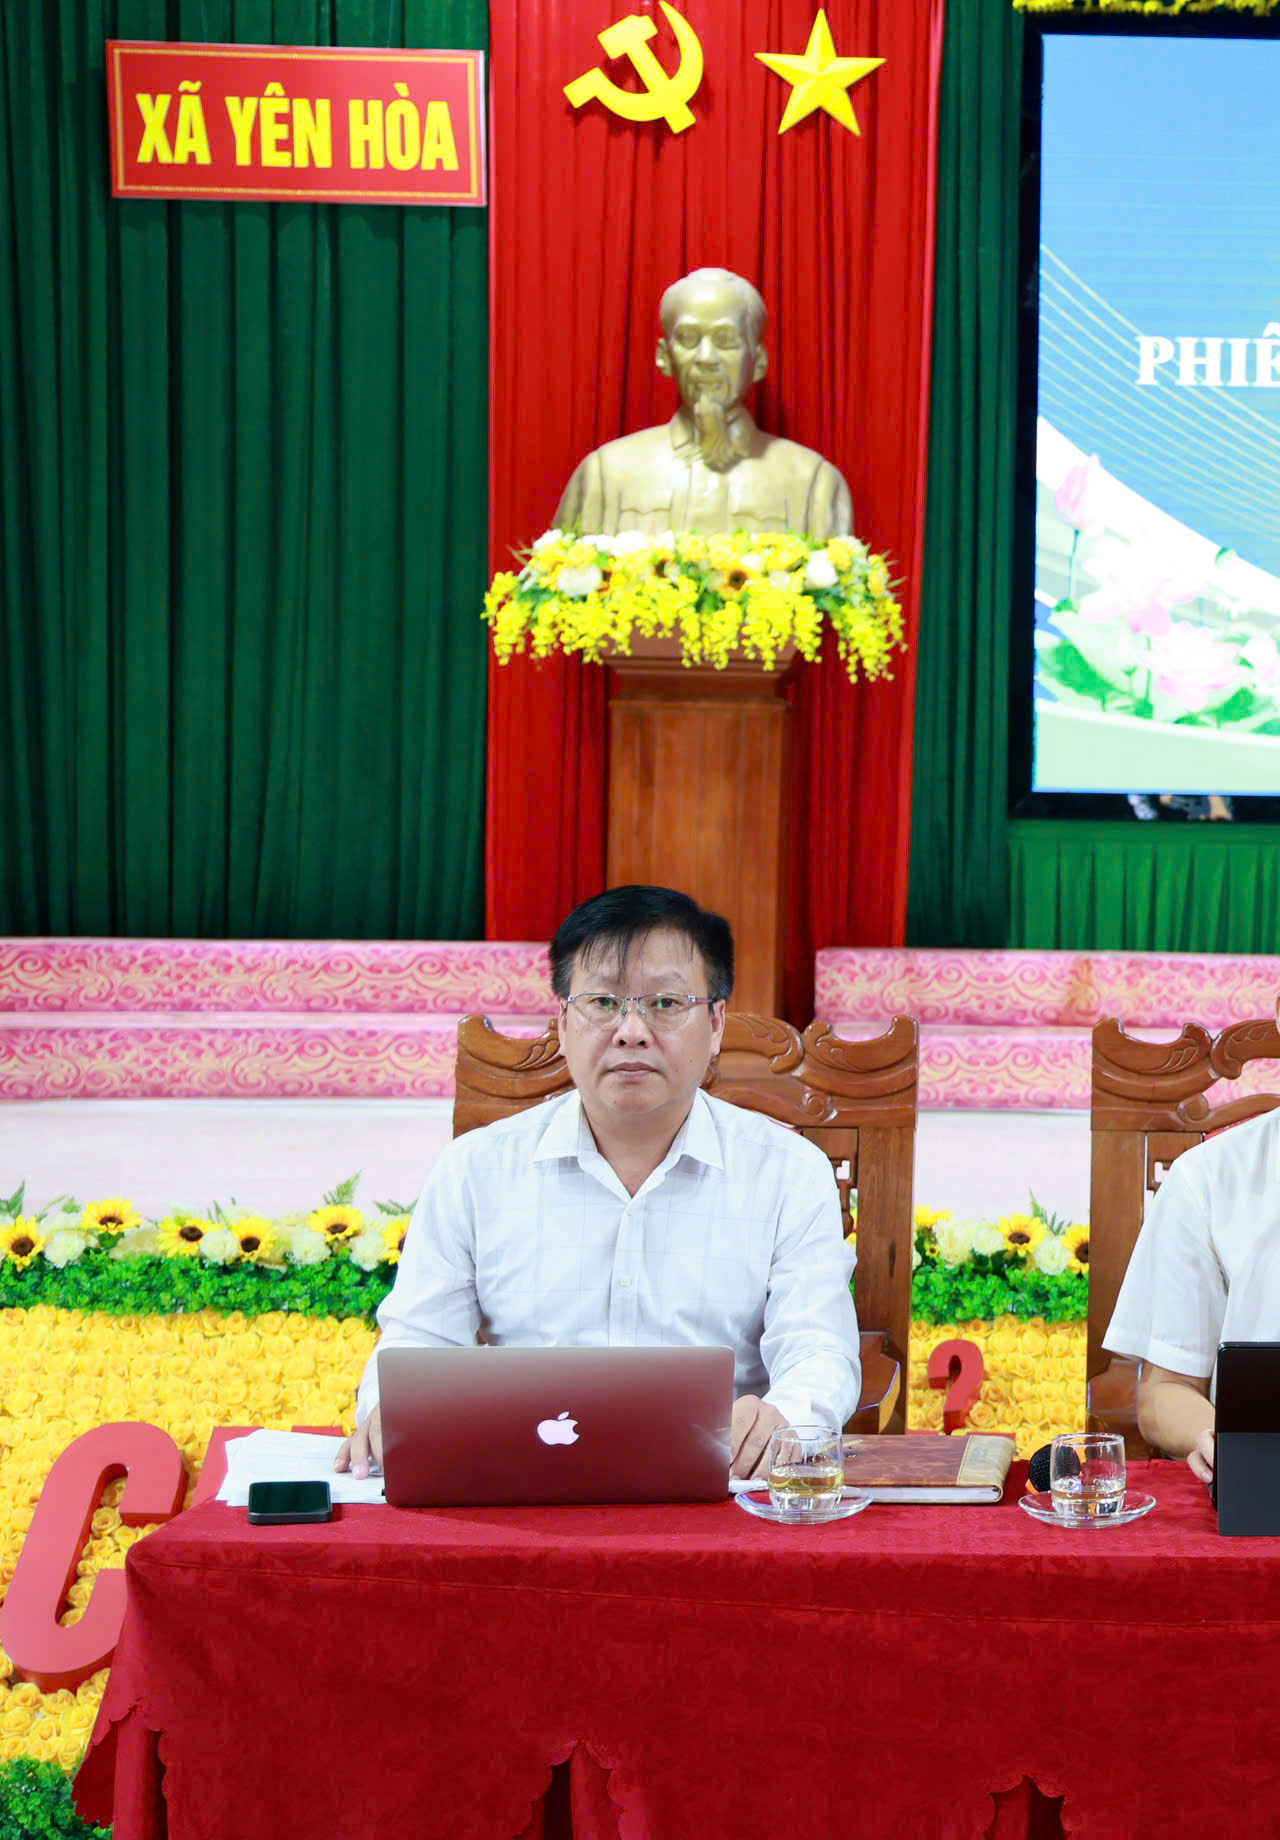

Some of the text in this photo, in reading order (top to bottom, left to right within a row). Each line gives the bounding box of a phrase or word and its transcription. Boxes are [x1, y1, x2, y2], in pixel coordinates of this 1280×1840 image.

[136, 80, 460, 171] XÃ YÊN HÒA
